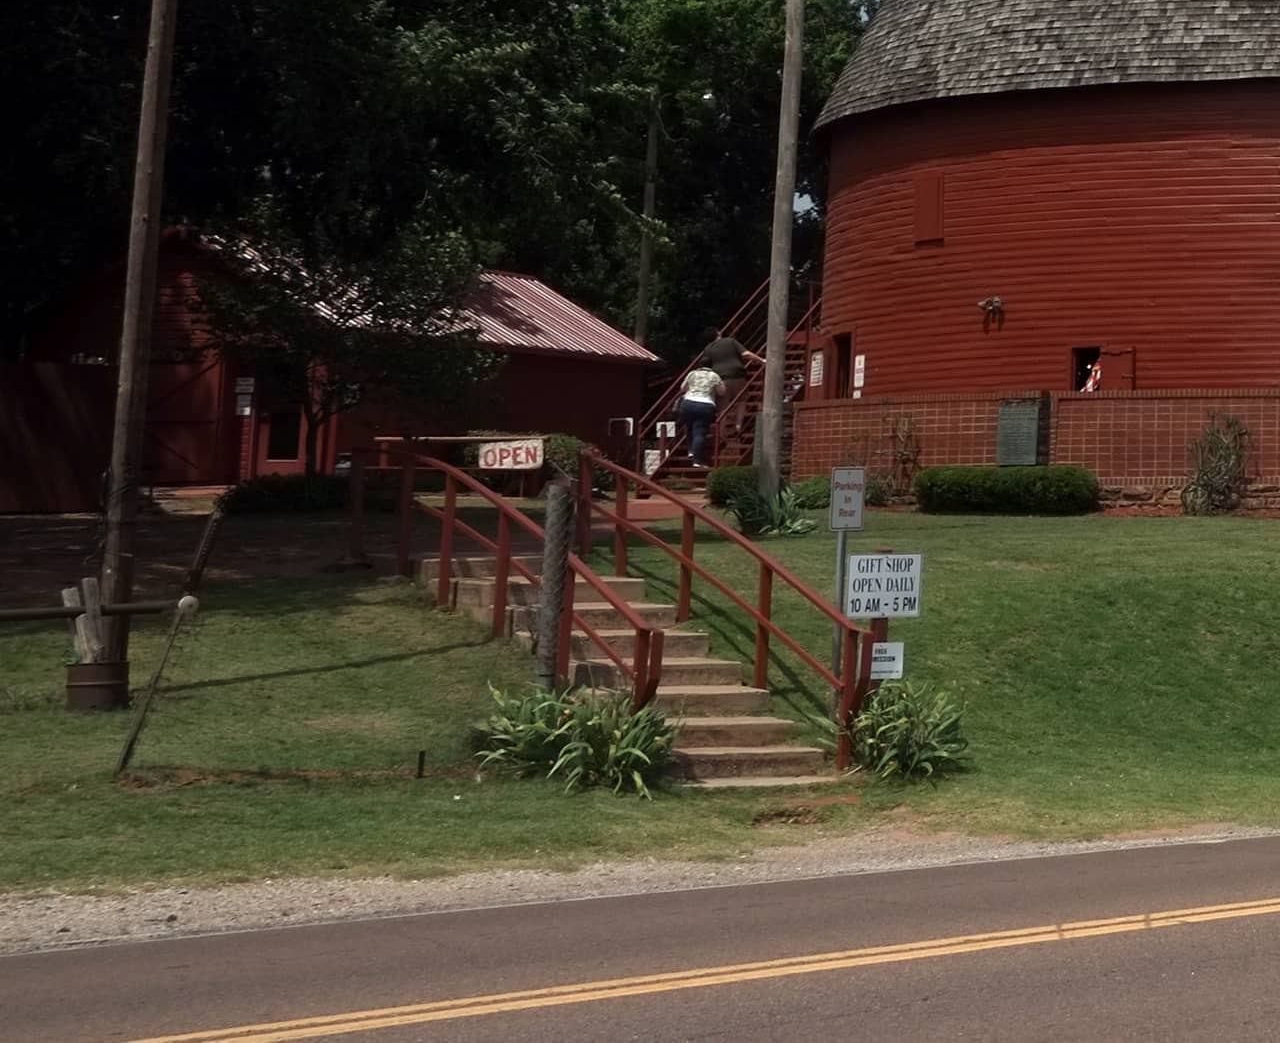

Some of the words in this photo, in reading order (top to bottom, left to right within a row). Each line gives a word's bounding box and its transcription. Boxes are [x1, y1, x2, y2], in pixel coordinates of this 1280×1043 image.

[484, 446, 537, 467] OPEN
[835, 481, 863, 493] Parking
[857, 558, 881, 573] GIFT
[885, 557, 914, 572] SHOP
[852, 578, 881, 593] OPEN
[886, 577, 916, 592] DAILY
[850, 598, 861, 613] 10
[865, 598, 880, 612] AM
[893, 597, 899, 612] 5
[902, 597, 917, 611] PM
